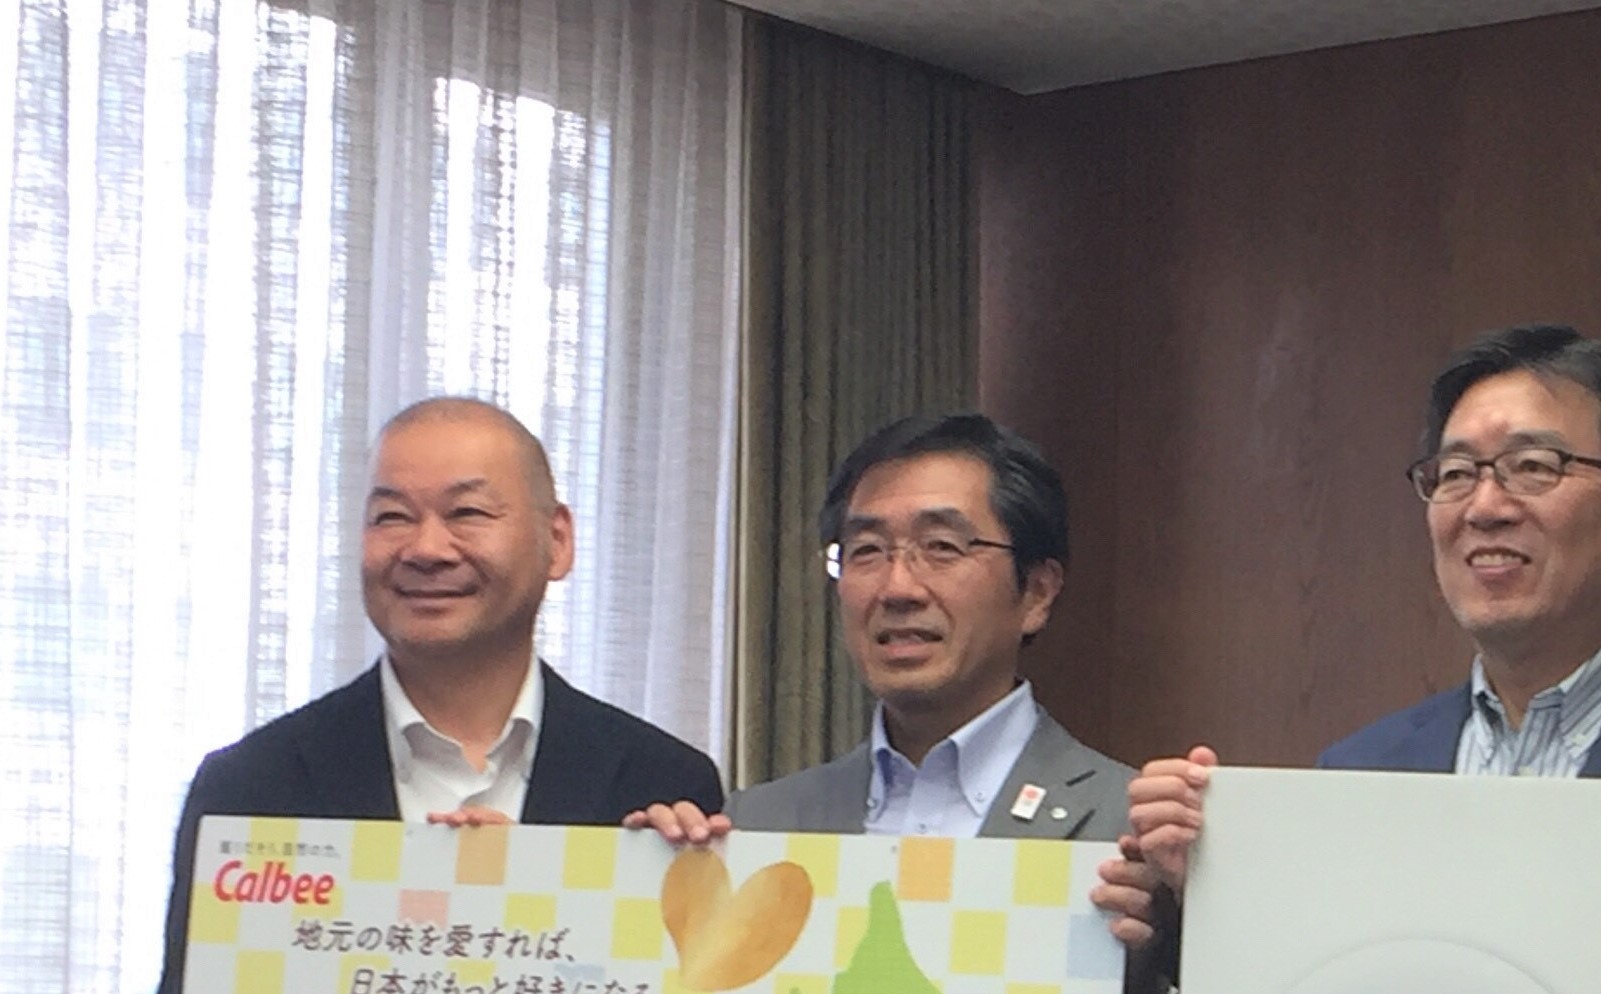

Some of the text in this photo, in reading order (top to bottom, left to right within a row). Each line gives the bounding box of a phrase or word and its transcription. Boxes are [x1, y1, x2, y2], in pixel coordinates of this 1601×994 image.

[213, 859, 335, 905] Calbee
[290, 920, 577, 963] 地元の味を愛すれば、
